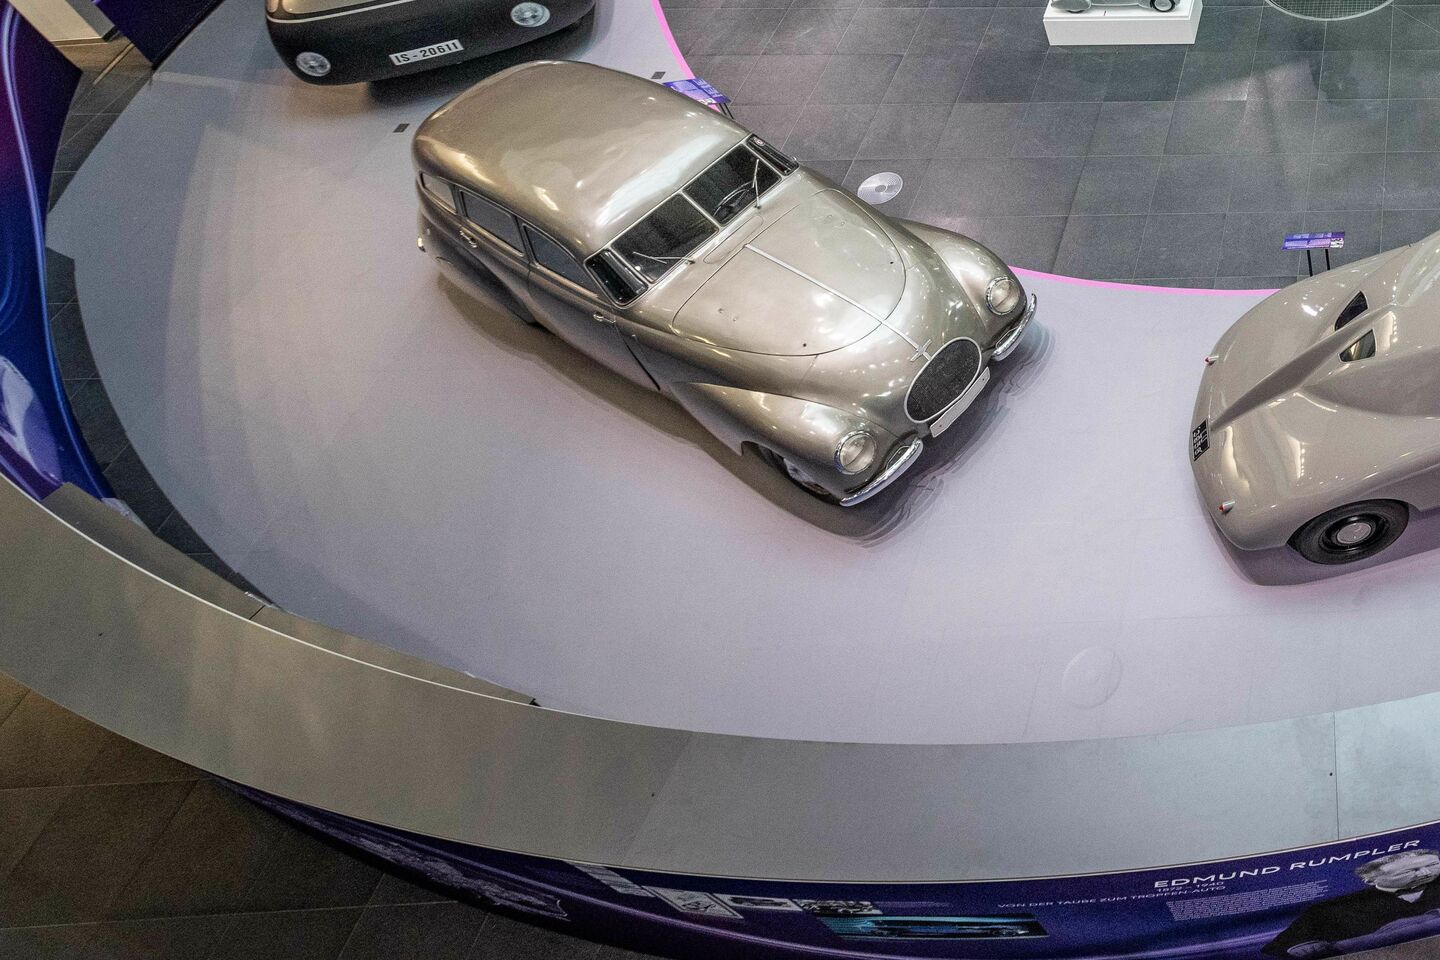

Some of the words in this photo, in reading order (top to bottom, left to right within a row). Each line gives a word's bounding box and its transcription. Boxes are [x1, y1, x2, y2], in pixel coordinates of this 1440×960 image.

[1153, 865, 1281, 889] EDMUND
[1289, 839, 1421, 871] RUMPLER
[1056, 898, 1097, 906] TAUBE
